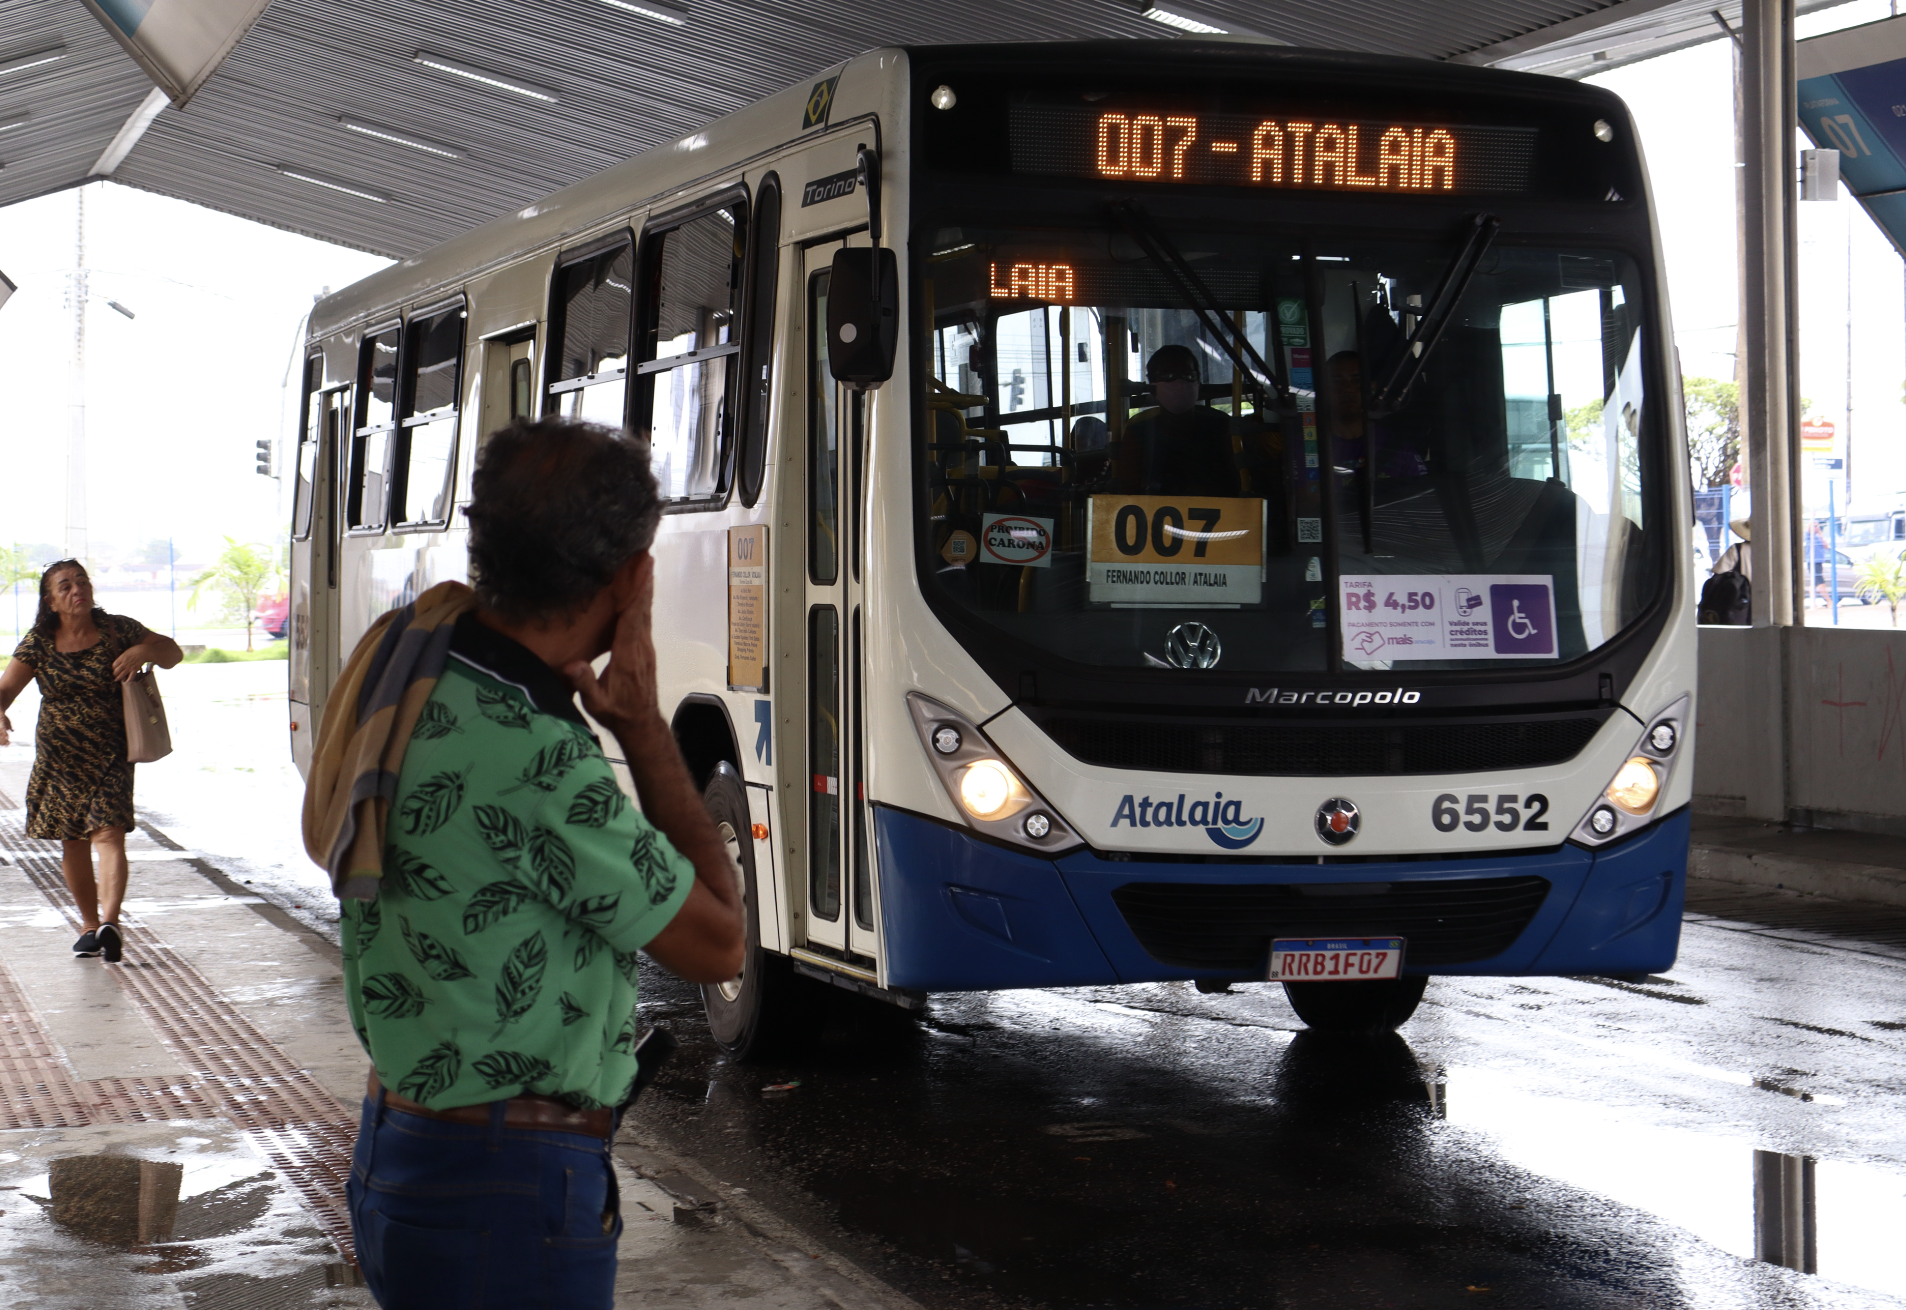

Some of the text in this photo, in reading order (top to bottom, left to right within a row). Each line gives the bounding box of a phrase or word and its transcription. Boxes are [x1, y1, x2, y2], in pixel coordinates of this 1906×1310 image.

[1821, 114, 1872, 158] 07
[1098, 114, 1197, 178] 007
[1252, 120, 1454, 189] ATALAIA
[805, 178, 856, 204] Torino
[990, 262, 1073, 298] LAIA
[1115, 504, 1221, 558] 007
[737, 537, 755, 560] 007
[988, 537, 1046, 551] CARONA
[1106, 569, 1151, 585] FERNANDO
[1153, 571, 1187, 586] COLLOR
[1192, 573, 1228, 588] ATALAIA
[1346, 589, 1435, 614] R$ 4,50
[1387, 634, 1414, 645] mais
[1449, 628, 1488, 636] créditos
[1244, 687, 1421, 708] Marcopolo
[1109, 791, 1253, 828] Atalaia
[1431, 793, 1550, 832] 6552
[1281, 951, 1388, 976] RRB1F07
